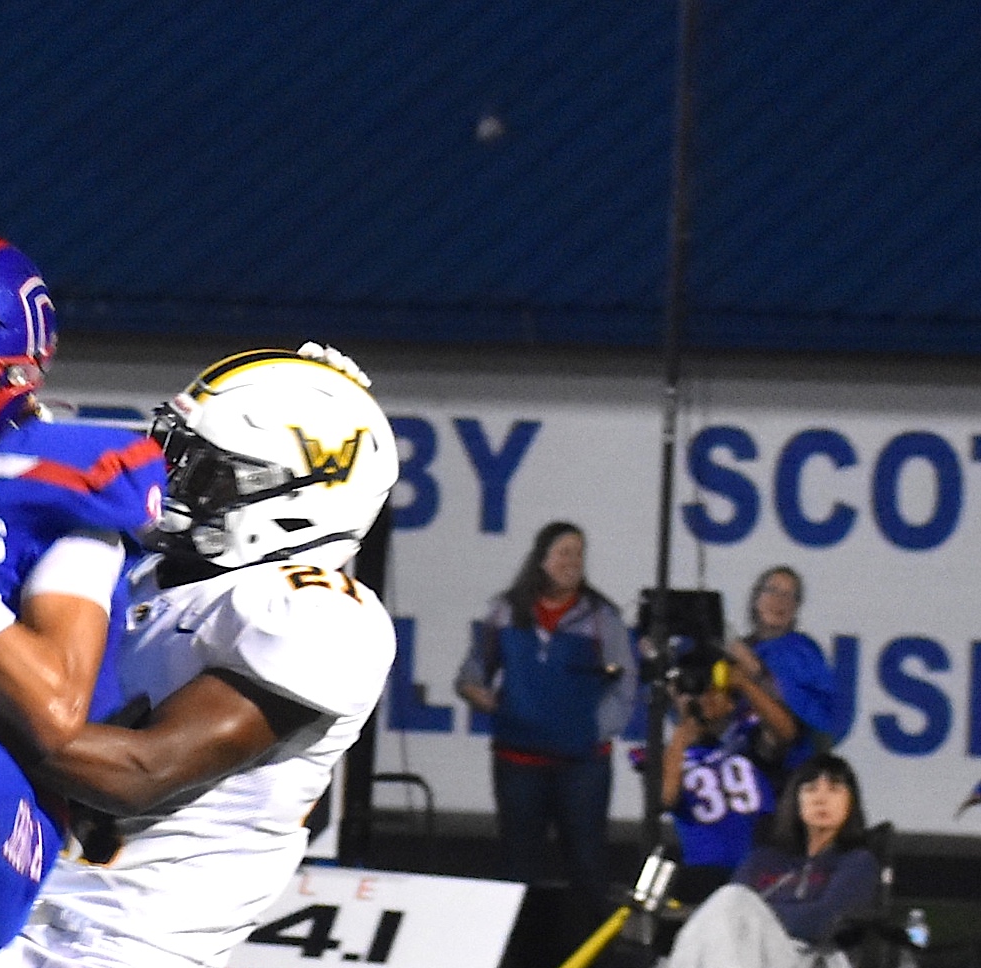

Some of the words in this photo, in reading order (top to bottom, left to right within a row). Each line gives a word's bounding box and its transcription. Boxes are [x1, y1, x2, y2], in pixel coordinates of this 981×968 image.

[285, 425, 368, 489] W
[682, 425, 981, 552] SCO
[683, 755, 761, 823] 39
